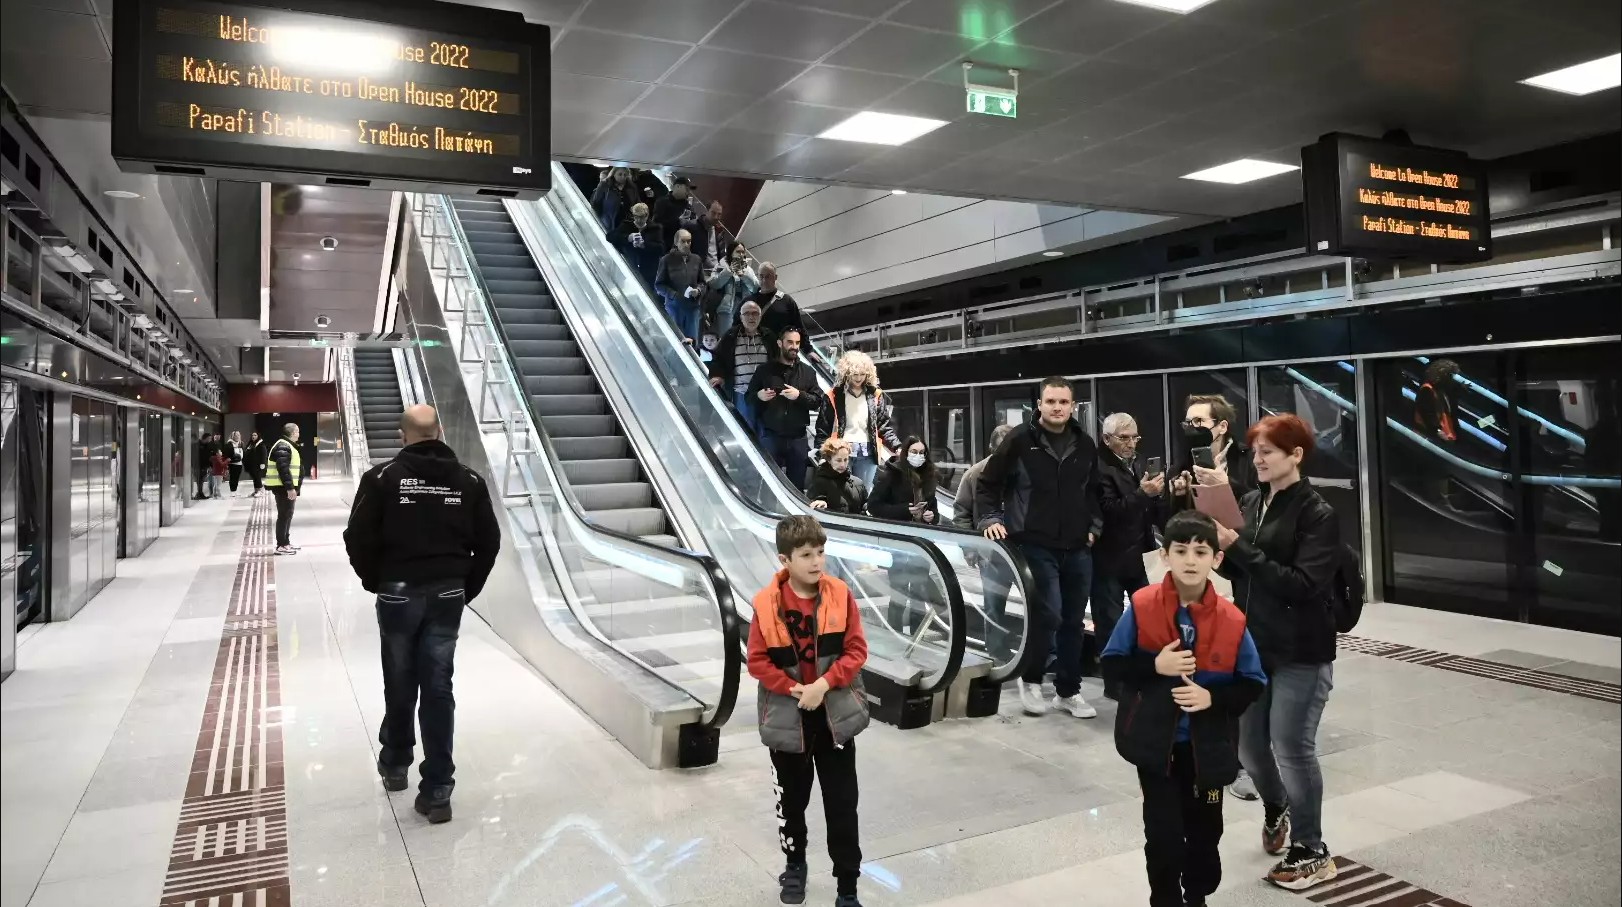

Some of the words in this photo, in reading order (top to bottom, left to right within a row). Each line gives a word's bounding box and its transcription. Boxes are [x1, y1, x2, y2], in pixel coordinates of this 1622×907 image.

[430, 42, 469, 69] 2022
[247, 65, 313, 95] ήλθατε
[320, 80, 351, 98] στο
[358, 75, 399, 103] Open
[405, 81, 454, 109] House
[460, 87, 498, 114] 2022
[189, 103, 255, 134] Papafi
[261, 110, 336, 140] Station
[358, 119, 429, 148] Σταθμός
[435, 127, 493, 155] Παπάφη
[1370, 163, 1397, 180] Welcome
[1406, 167, 1423, 184] Open
[1423, 170, 1443, 187] House
[1442, 173, 1459, 189] 2022
[1419, 195, 1436, 211] Open
[1435, 197, 1455, 214] House
[1455, 199, 1471, 216] 2022
[1363, 215, 1387, 233] Papafi
[1387, 217, 1415, 235] Station
[400, 478, 418, 486] RES
